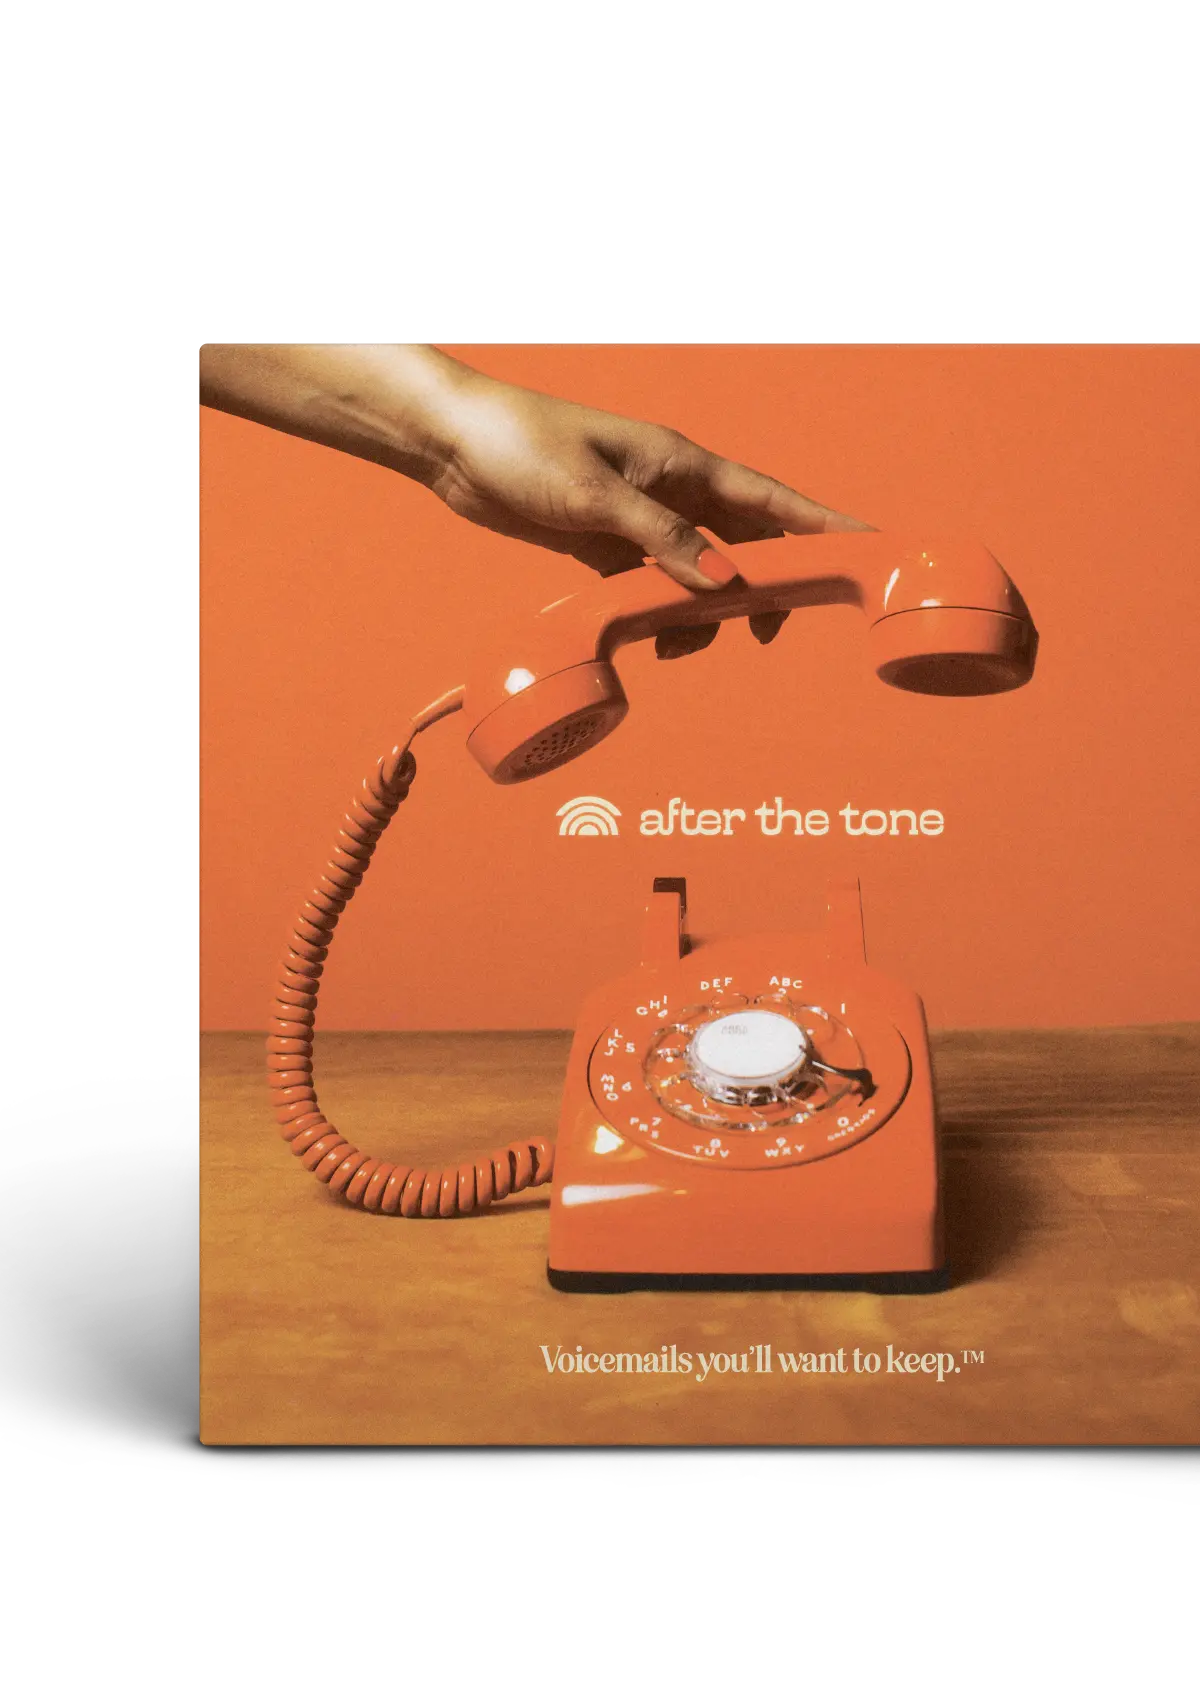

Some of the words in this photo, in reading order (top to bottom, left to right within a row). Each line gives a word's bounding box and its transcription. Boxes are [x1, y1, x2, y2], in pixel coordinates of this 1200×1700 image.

[640, 797, 746, 836] after
[754, 797, 830, 836] the
[838, 802, 945, 836] tone
[700, 977, 733, 991] DEF
[769, 975, 803, 989] ABC
[539, 1344, 693, 1373] Voicemails
[695, 1344, 772, 1382] you’ll
[777, 1347, 848, 1373] want
[852, 1347, 881, 1373] to
